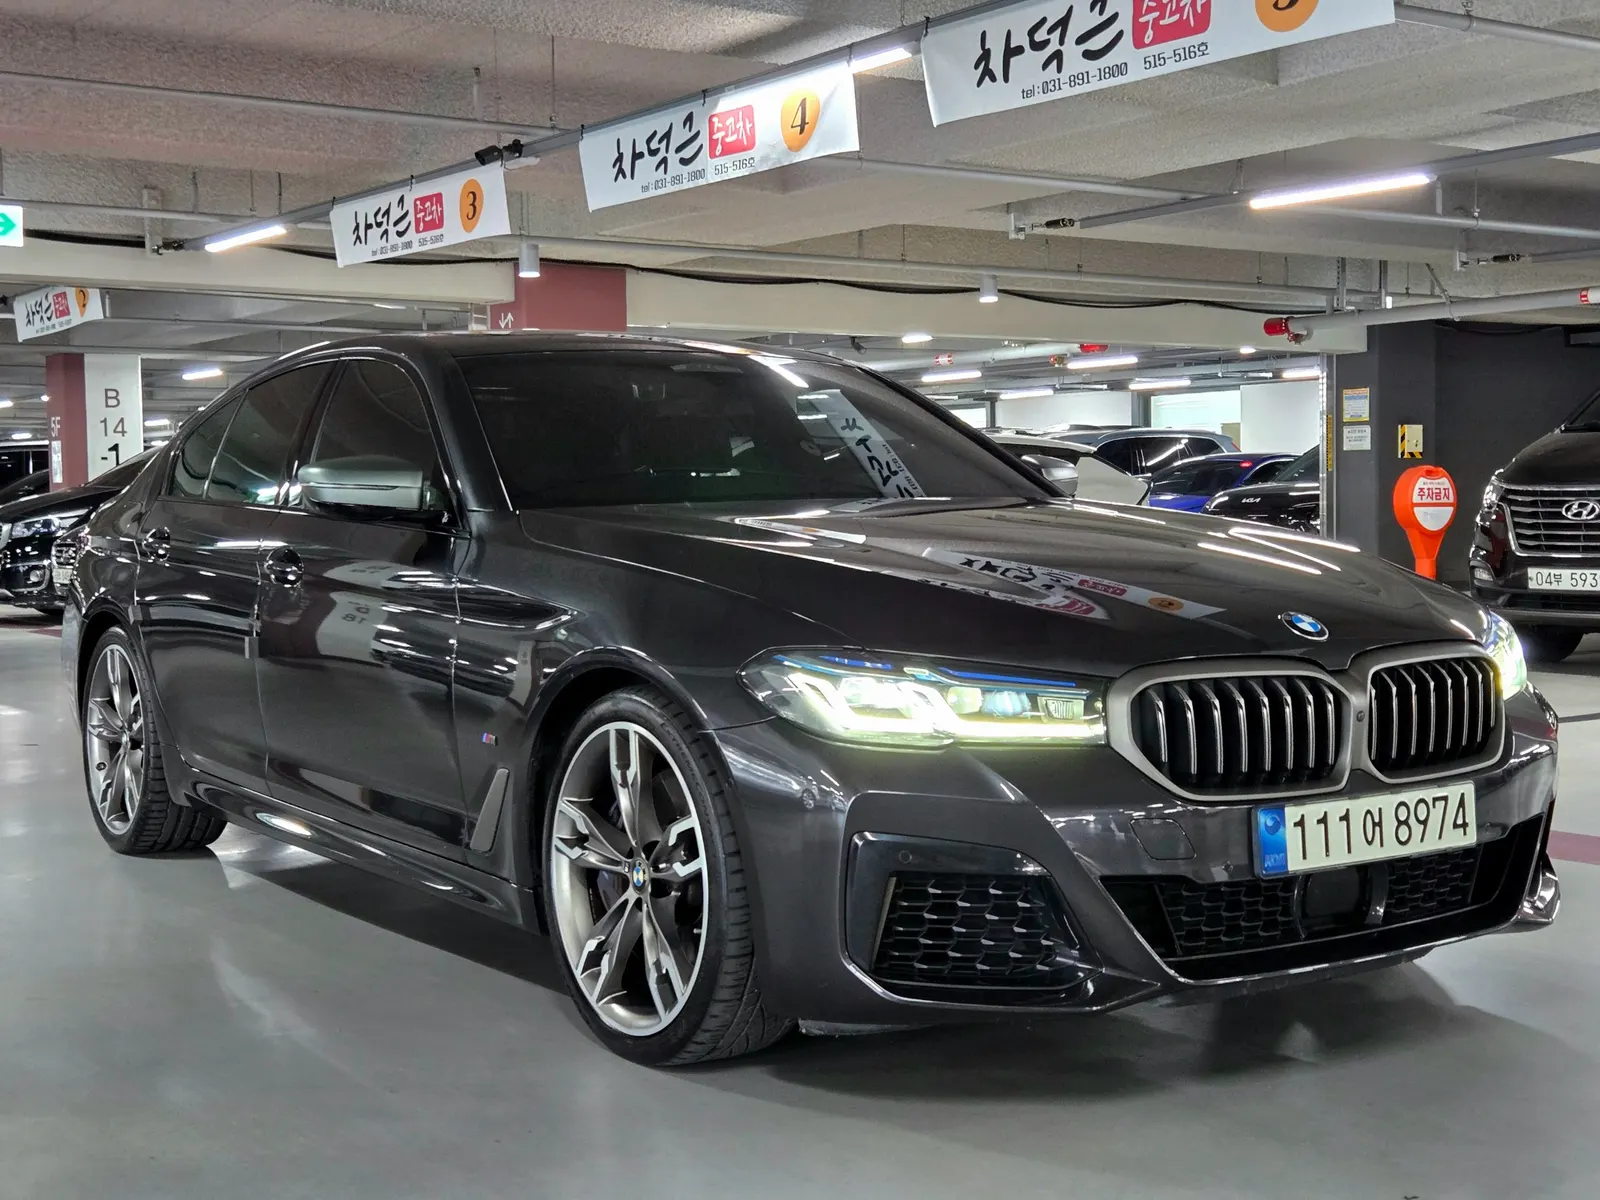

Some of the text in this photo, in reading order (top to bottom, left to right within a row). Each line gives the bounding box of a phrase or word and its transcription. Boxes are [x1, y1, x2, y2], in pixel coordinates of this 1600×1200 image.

[1143, 42, 1210, 71] 515-516호
[713, 111, 753, 156] 중고차
[791, 97, 809, 136] 4
[714, 156, 756, 176] 515-516호
[416, 197, 442, 232] 중고차
[466, 191, 477, 220] 3
[104, 388, 120, 408] B
[51, 416, 61, 437] 5F
[100, 417, 127, 437] 14
[101, 443, 120, 467] -1
[1417, 487, 1450, 501] 주차금지
[1535, 571, 1600, 588] 04부 593
[1293, 792, 1469, 860] 111어 8974
